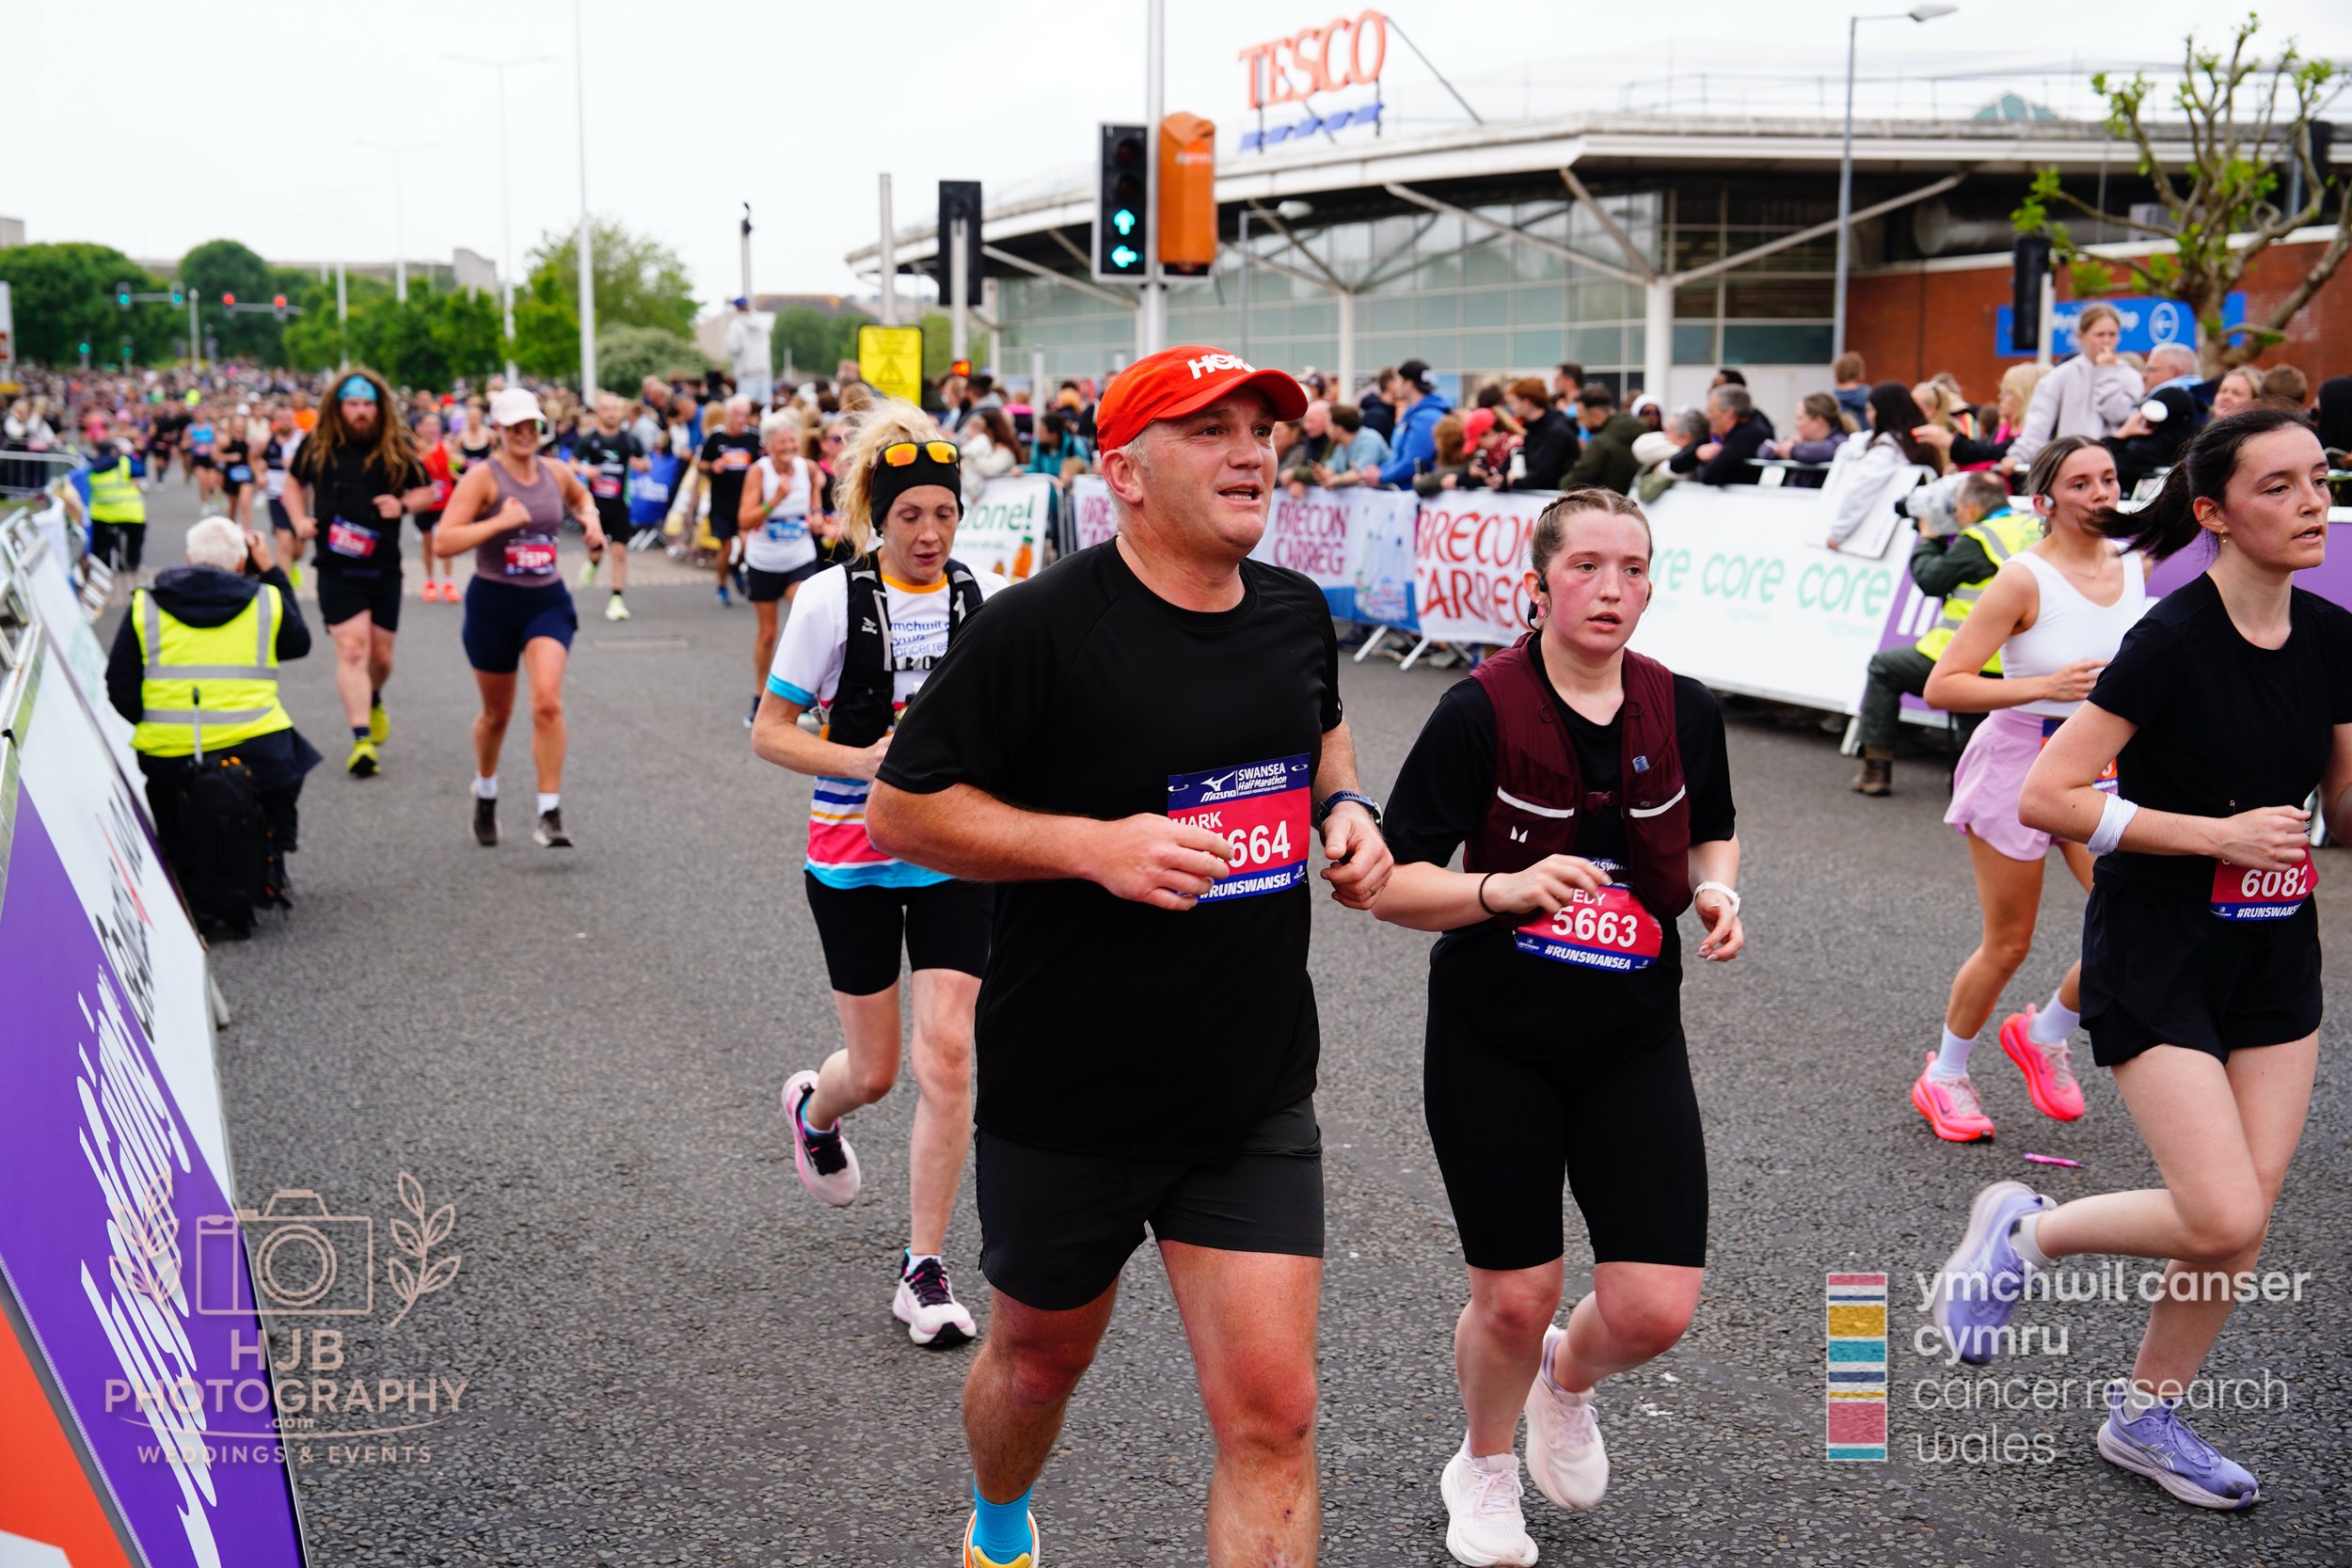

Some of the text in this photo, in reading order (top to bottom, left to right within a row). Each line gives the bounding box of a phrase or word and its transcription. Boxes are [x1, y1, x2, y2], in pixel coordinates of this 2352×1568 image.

[1239, 8, 1386, 109] TESCO
[1701, 551, 1785, 603] core
[1797, 562, 1892, 617] core
[891, 621, 941, 631] mchwil
[1238, 763, 1286, 781] SWANSEA
[1216, 820, 1291, 868] 664
[1552, 906, 1638, 948] 5663
[1545, 944, 1631, 971] #RUNSWANSEA
[76, 978, 222, 1568] JustGiving
